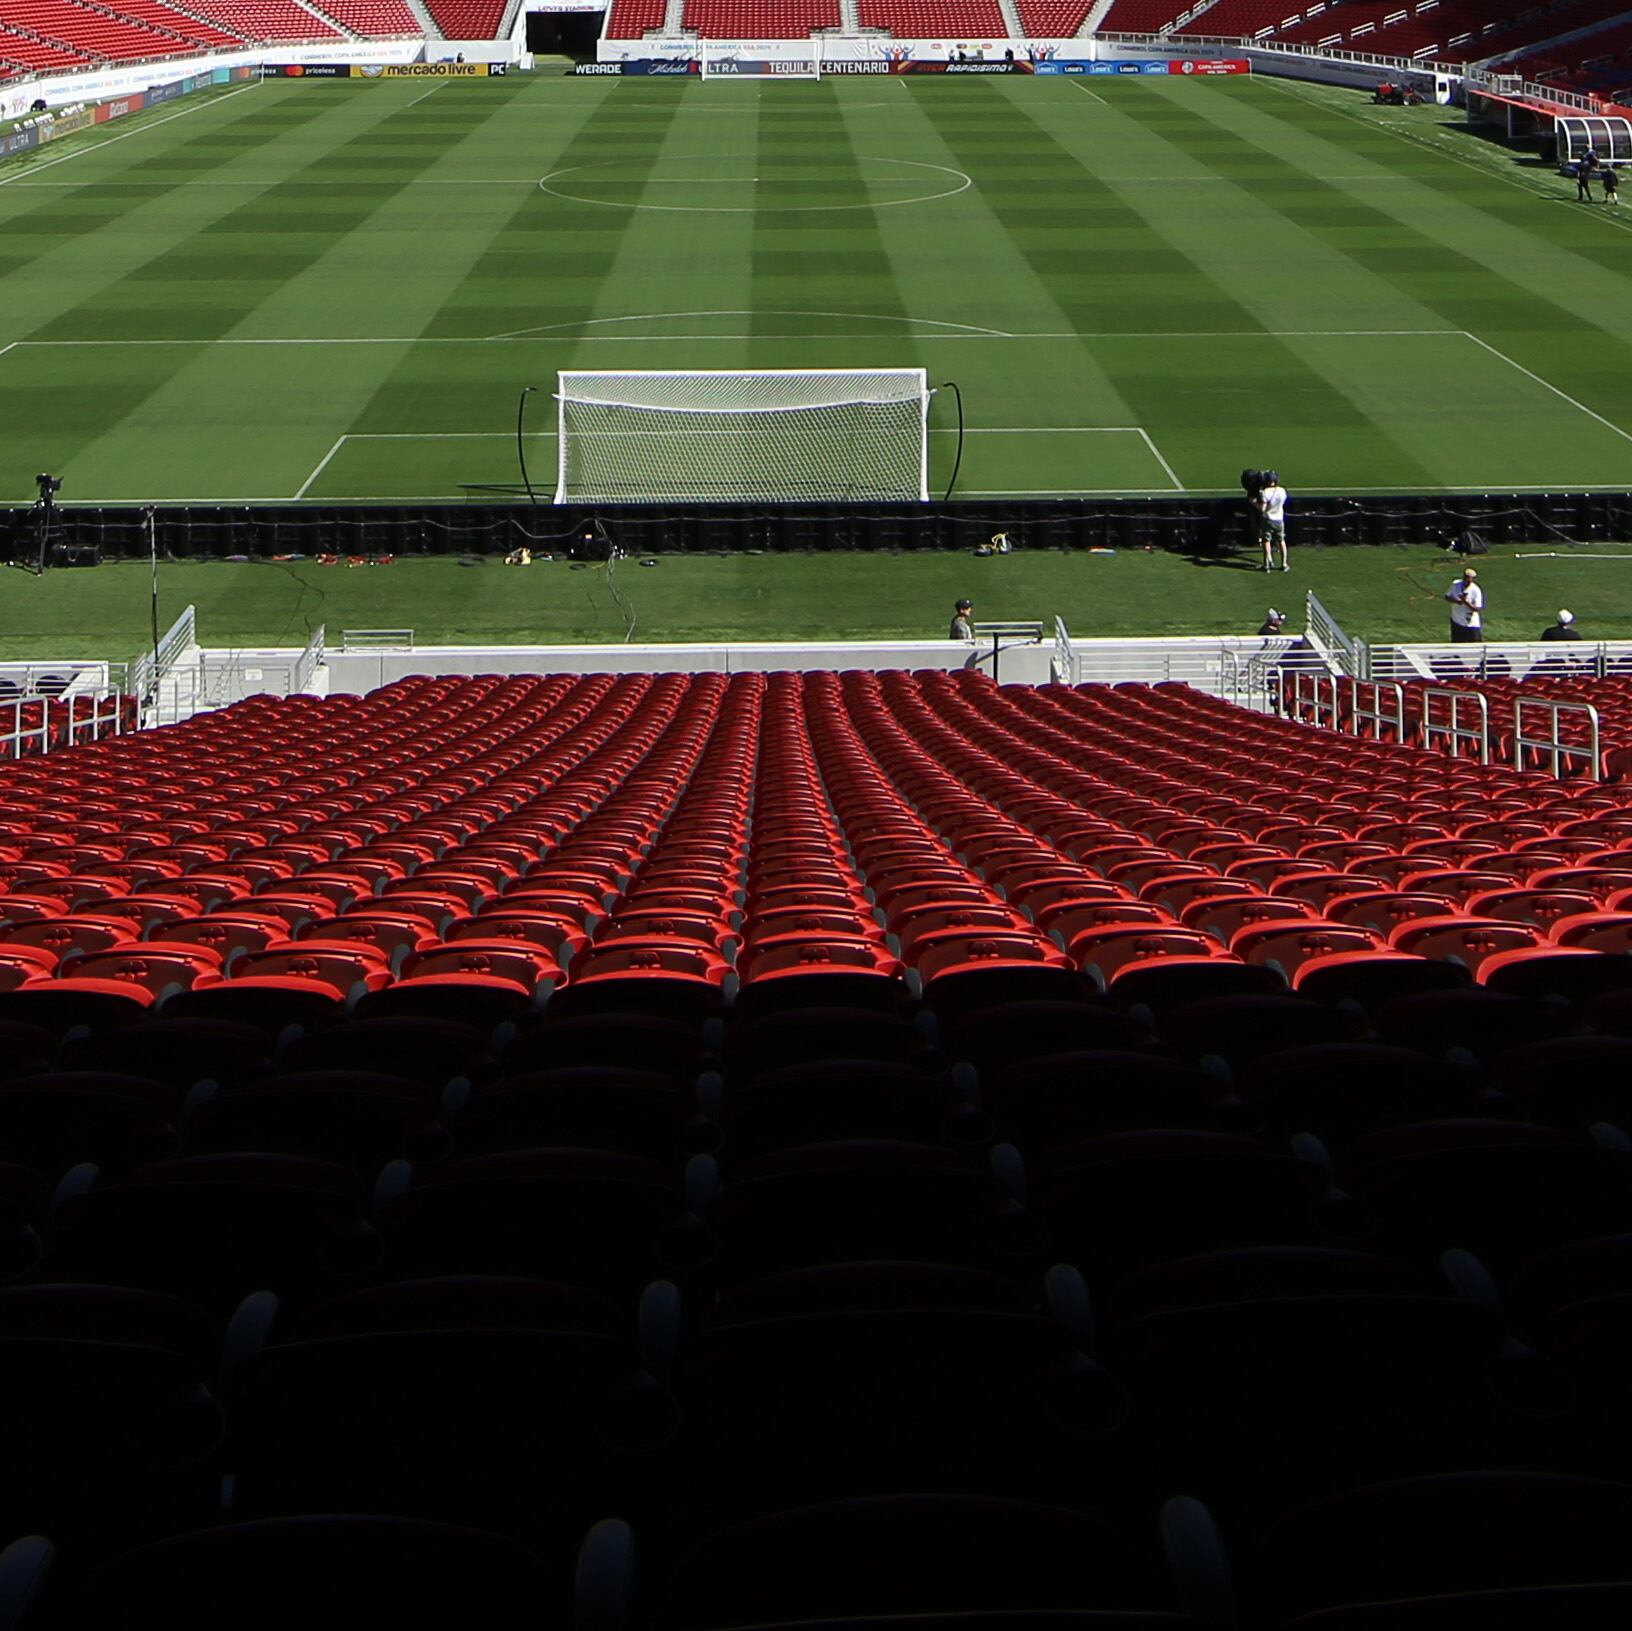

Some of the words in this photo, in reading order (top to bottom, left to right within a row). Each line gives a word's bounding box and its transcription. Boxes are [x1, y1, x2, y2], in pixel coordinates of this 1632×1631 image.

[387, 63, 448, 75] mercado
[448, 63, 476, 75] livre
[769, 62, 814, 74] TEQUILA
[820, 62, 890, 74] CENTENARIO
